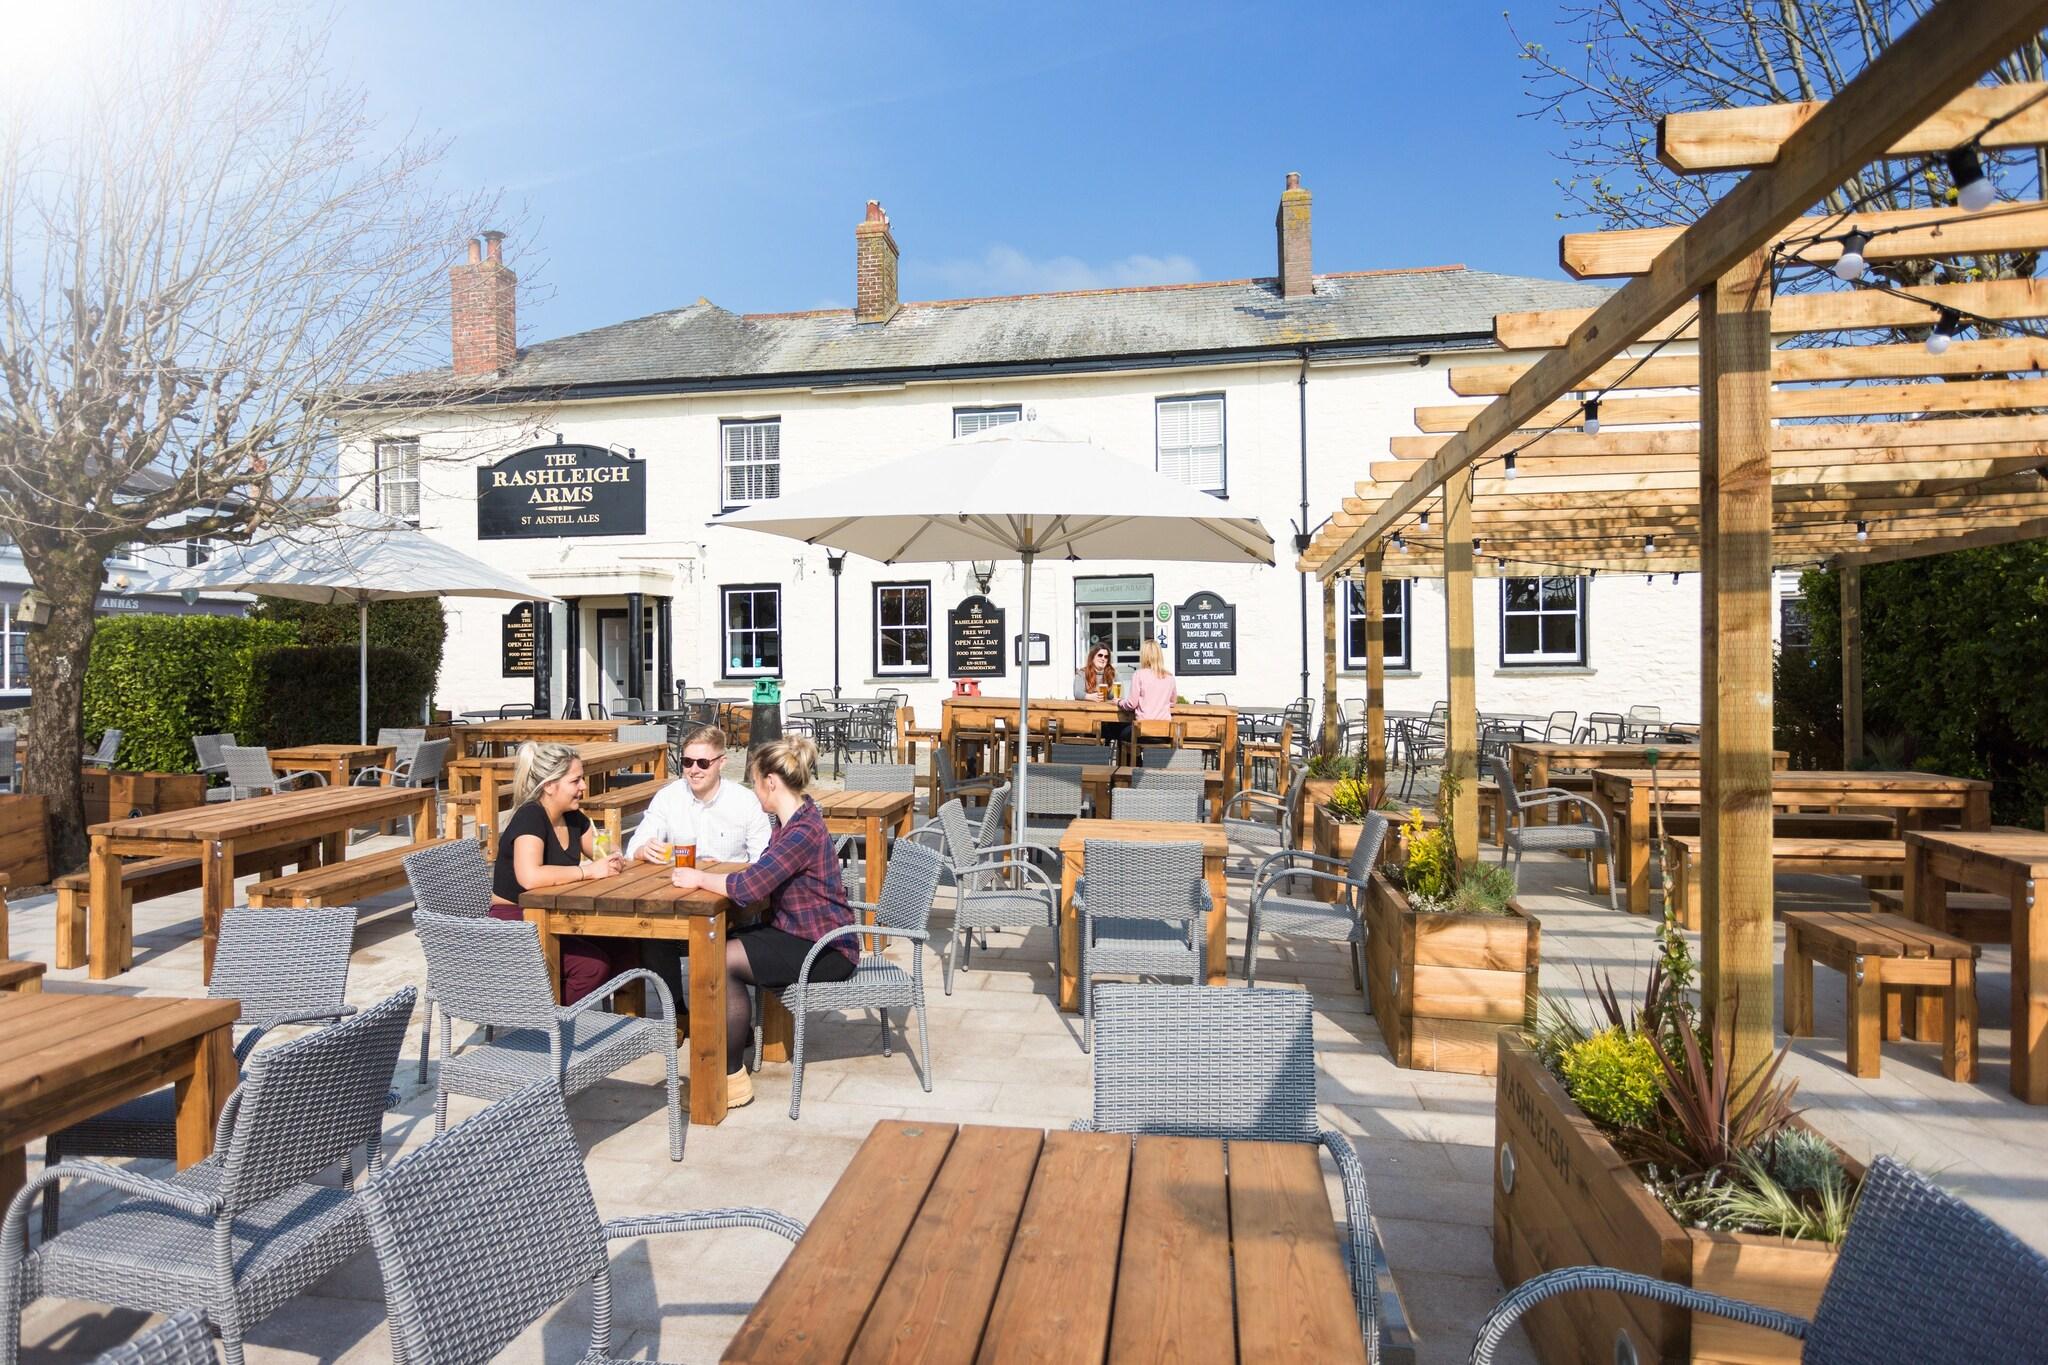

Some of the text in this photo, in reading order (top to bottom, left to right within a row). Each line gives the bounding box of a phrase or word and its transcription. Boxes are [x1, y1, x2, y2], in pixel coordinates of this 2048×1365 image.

[544, 453, 577, 467] THE
[492, 466, 630, 487] RASHLEIGH
[527, 486, 594, 504] ARMS
[521, 514, 600, 525] ST AUSTELL ALES
[102, 598, 139, 609] ANNA'S
[1501, 1060, 1570, 1185] RASHLEIGH
